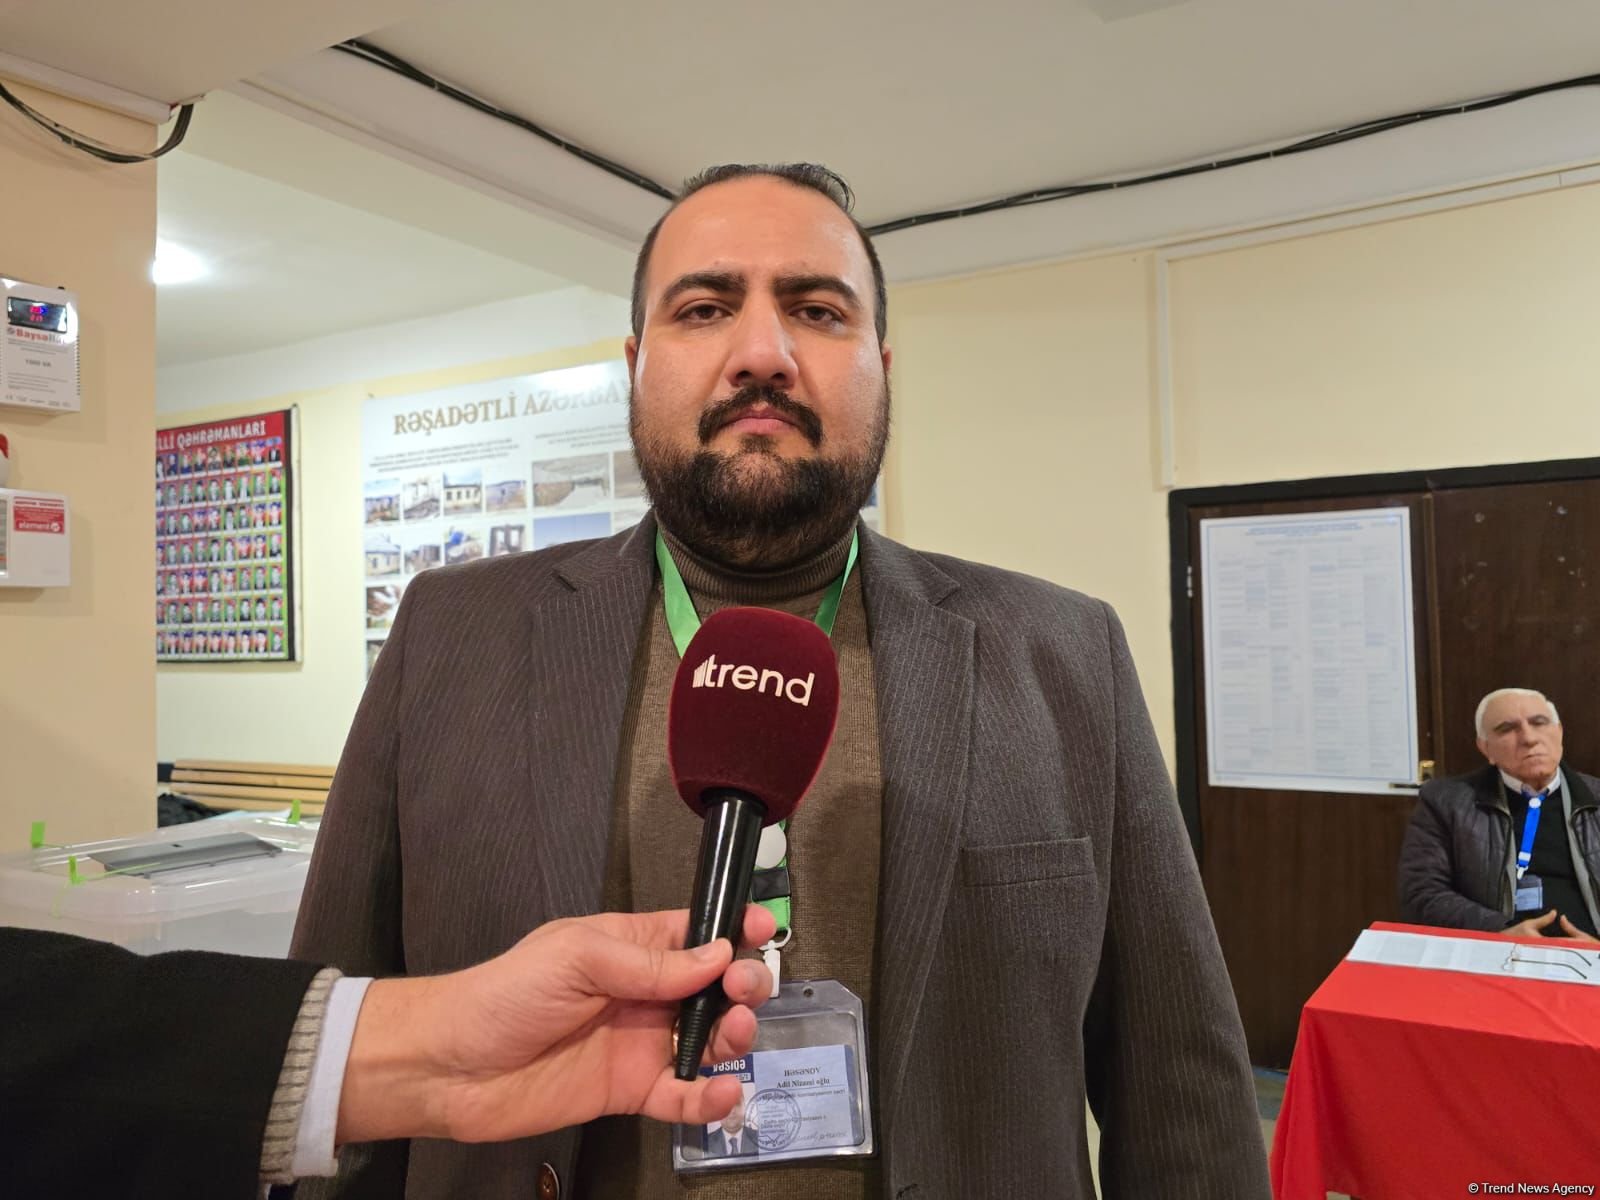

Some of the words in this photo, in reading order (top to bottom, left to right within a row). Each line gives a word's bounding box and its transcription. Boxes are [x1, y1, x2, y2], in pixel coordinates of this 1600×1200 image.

[393, 391, 518, 436] RƏŞADƏTLİ
[156, 431, 174, 451] LLİ
[704, 654, 815, 707] trend
